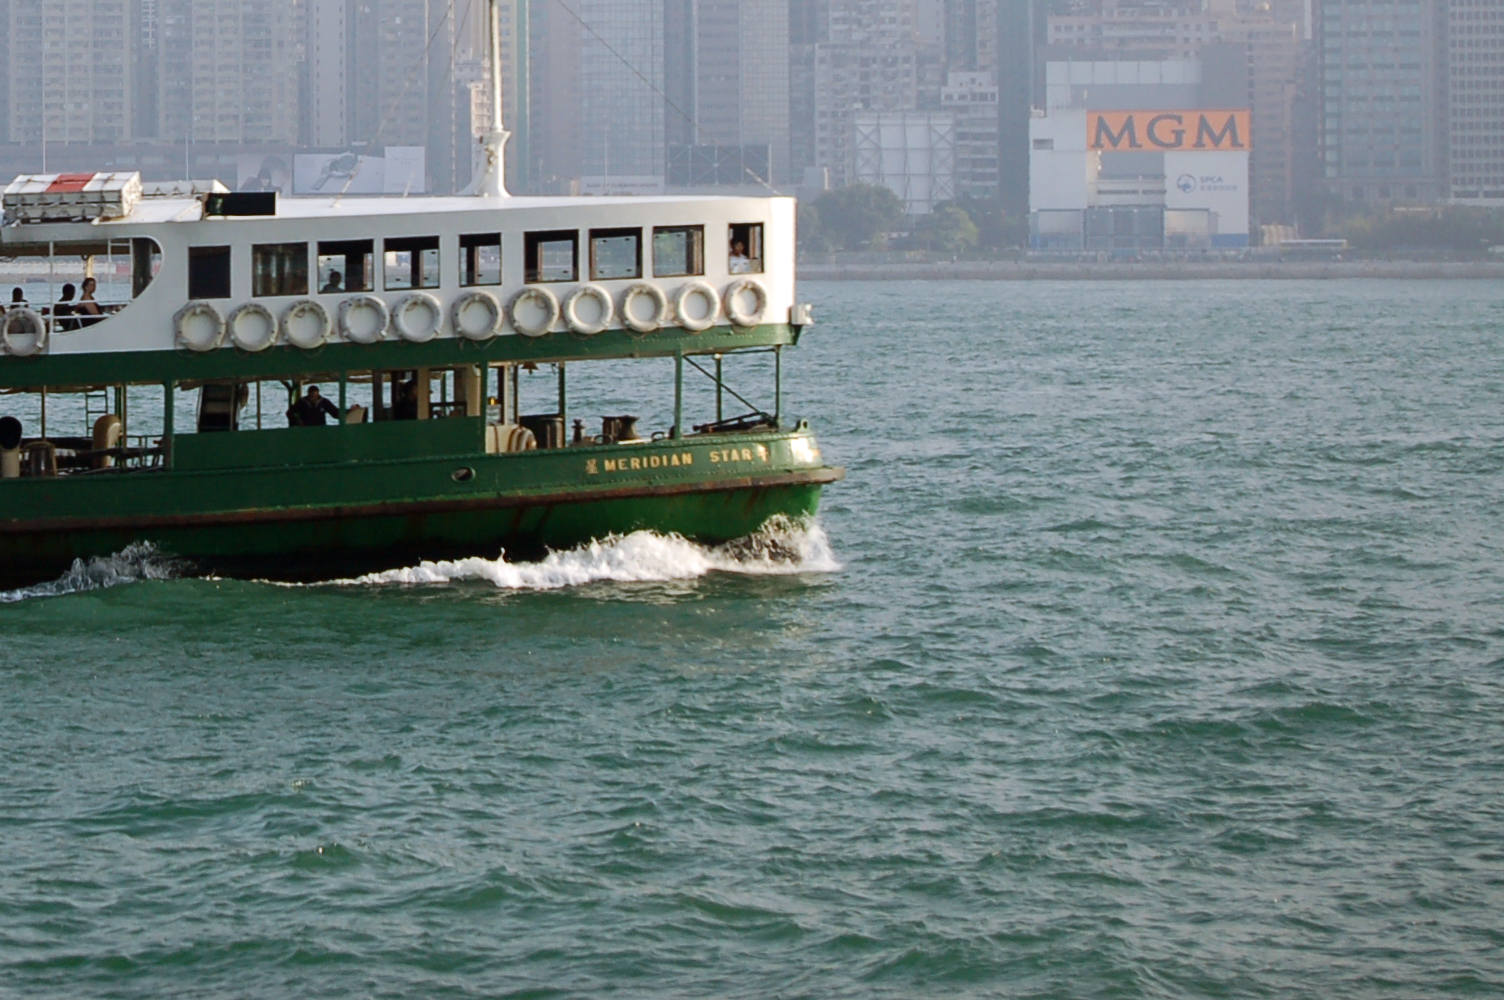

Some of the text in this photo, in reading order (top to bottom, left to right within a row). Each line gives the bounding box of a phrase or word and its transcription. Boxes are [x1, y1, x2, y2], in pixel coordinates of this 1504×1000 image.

[1091, 114, 1245, 149] MGM
[1200, 175, 1223, 184] SPCA
[604, 447, 753, 472] MERIDIAN STAR
